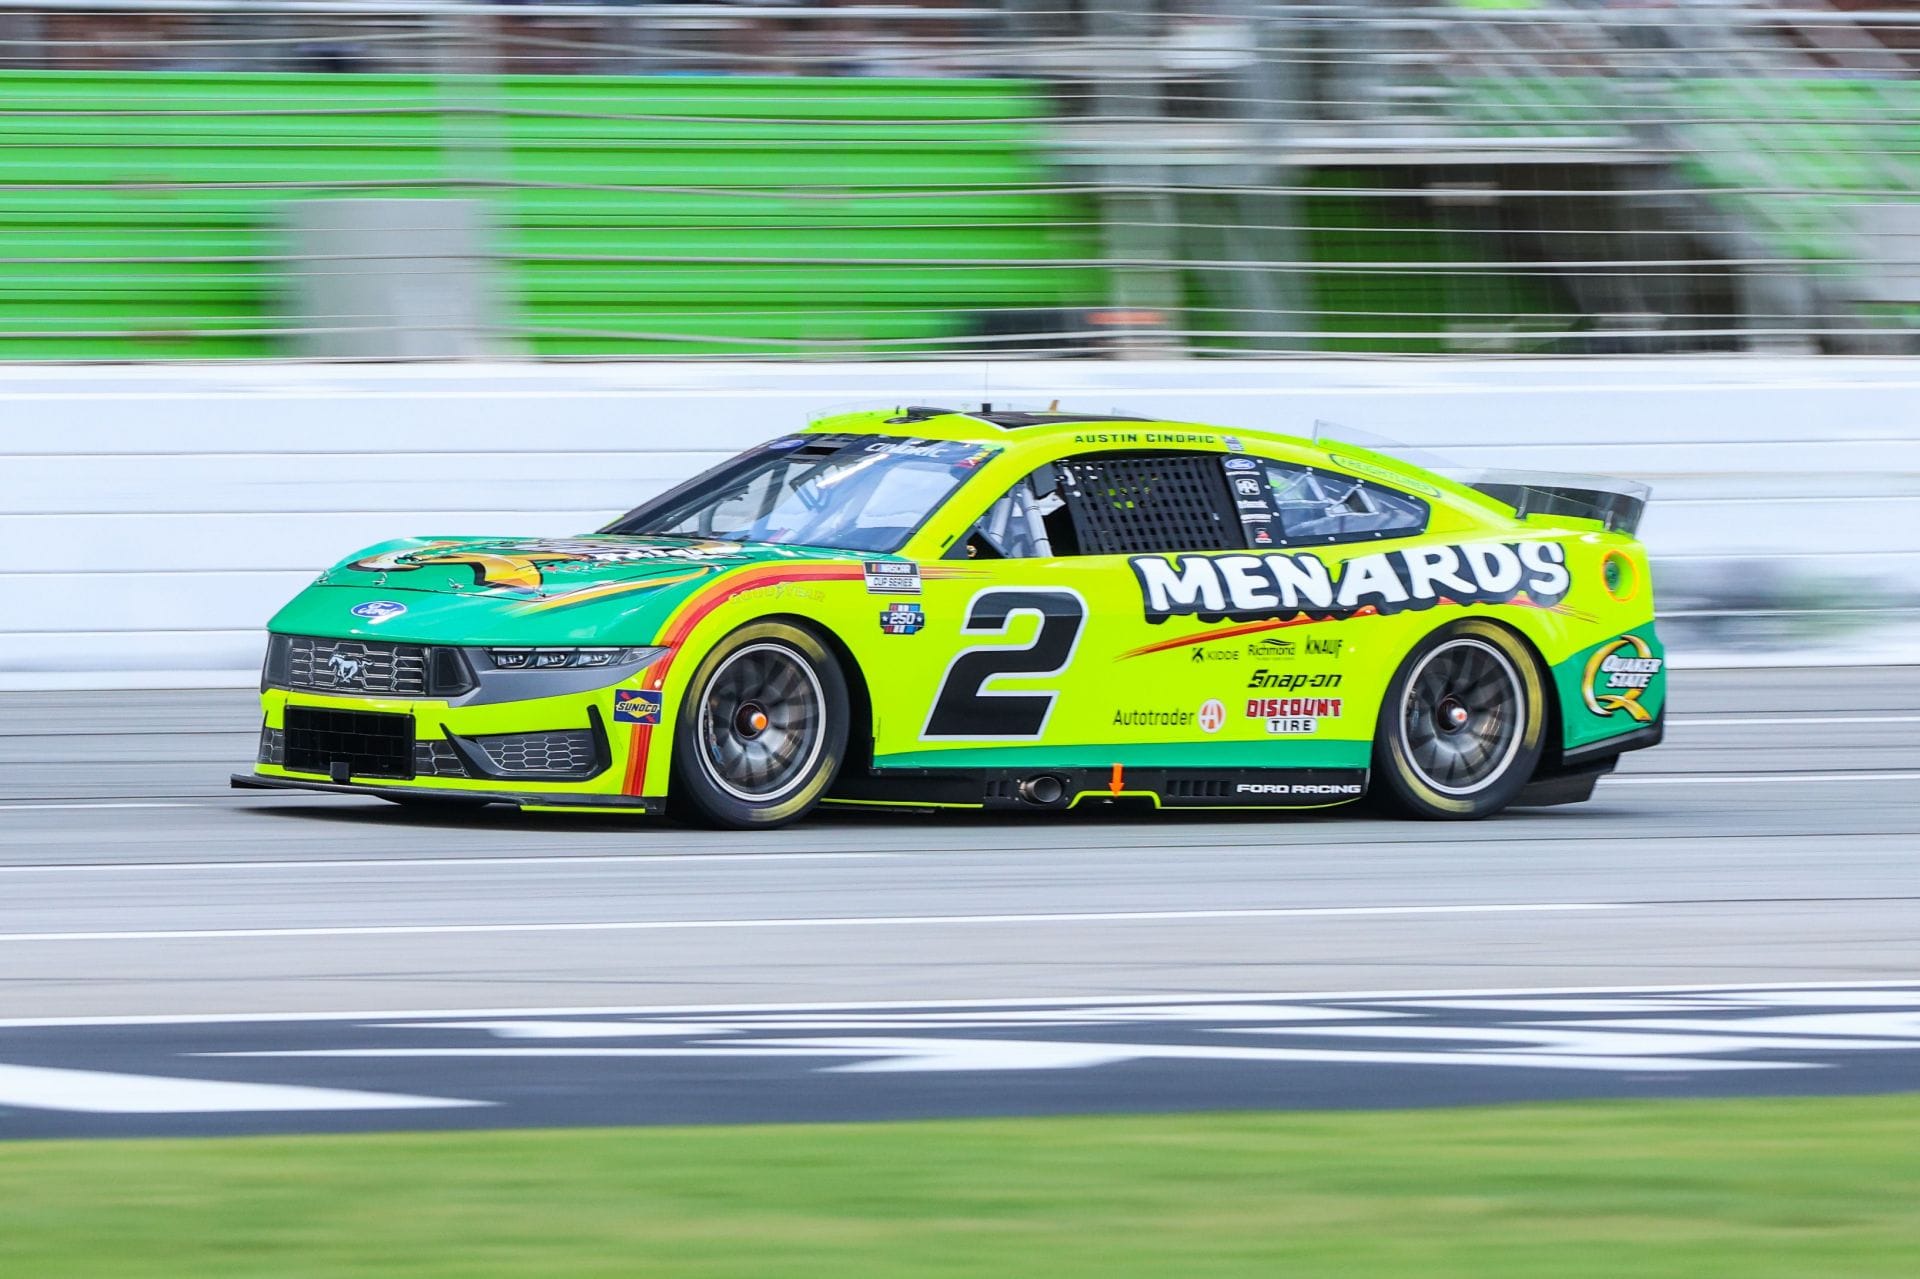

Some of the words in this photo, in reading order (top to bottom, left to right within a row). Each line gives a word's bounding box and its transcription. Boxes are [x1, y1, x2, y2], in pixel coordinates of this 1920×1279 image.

[1074, 433, 1137, 442] AUSTIN
[1146, 433, 1215, 444] CINDRIC
[1133, 542, 1566, 612] MENARDS
[889, 612, 916, 625] 250
[1305, 635, 1343, 658] KNAUF
[921, 586, 1088, 742] 2
[1601, 654, 1662, 673] QUAKER
[1247, 669, 1343, 692] Snap-on
[1606, 672, 1653, 688] STATE
[618, 702, 659, 712] SUNOCO
[1246, 698, 1342, 718] DISCOUNT
[1113, 709, 1195, 726] Autotrader
[1271, 719, 1312, 732] TIRE
[1236, 784, 1289, 794] FORD
[1291, 784, 1362, 794] RACING
